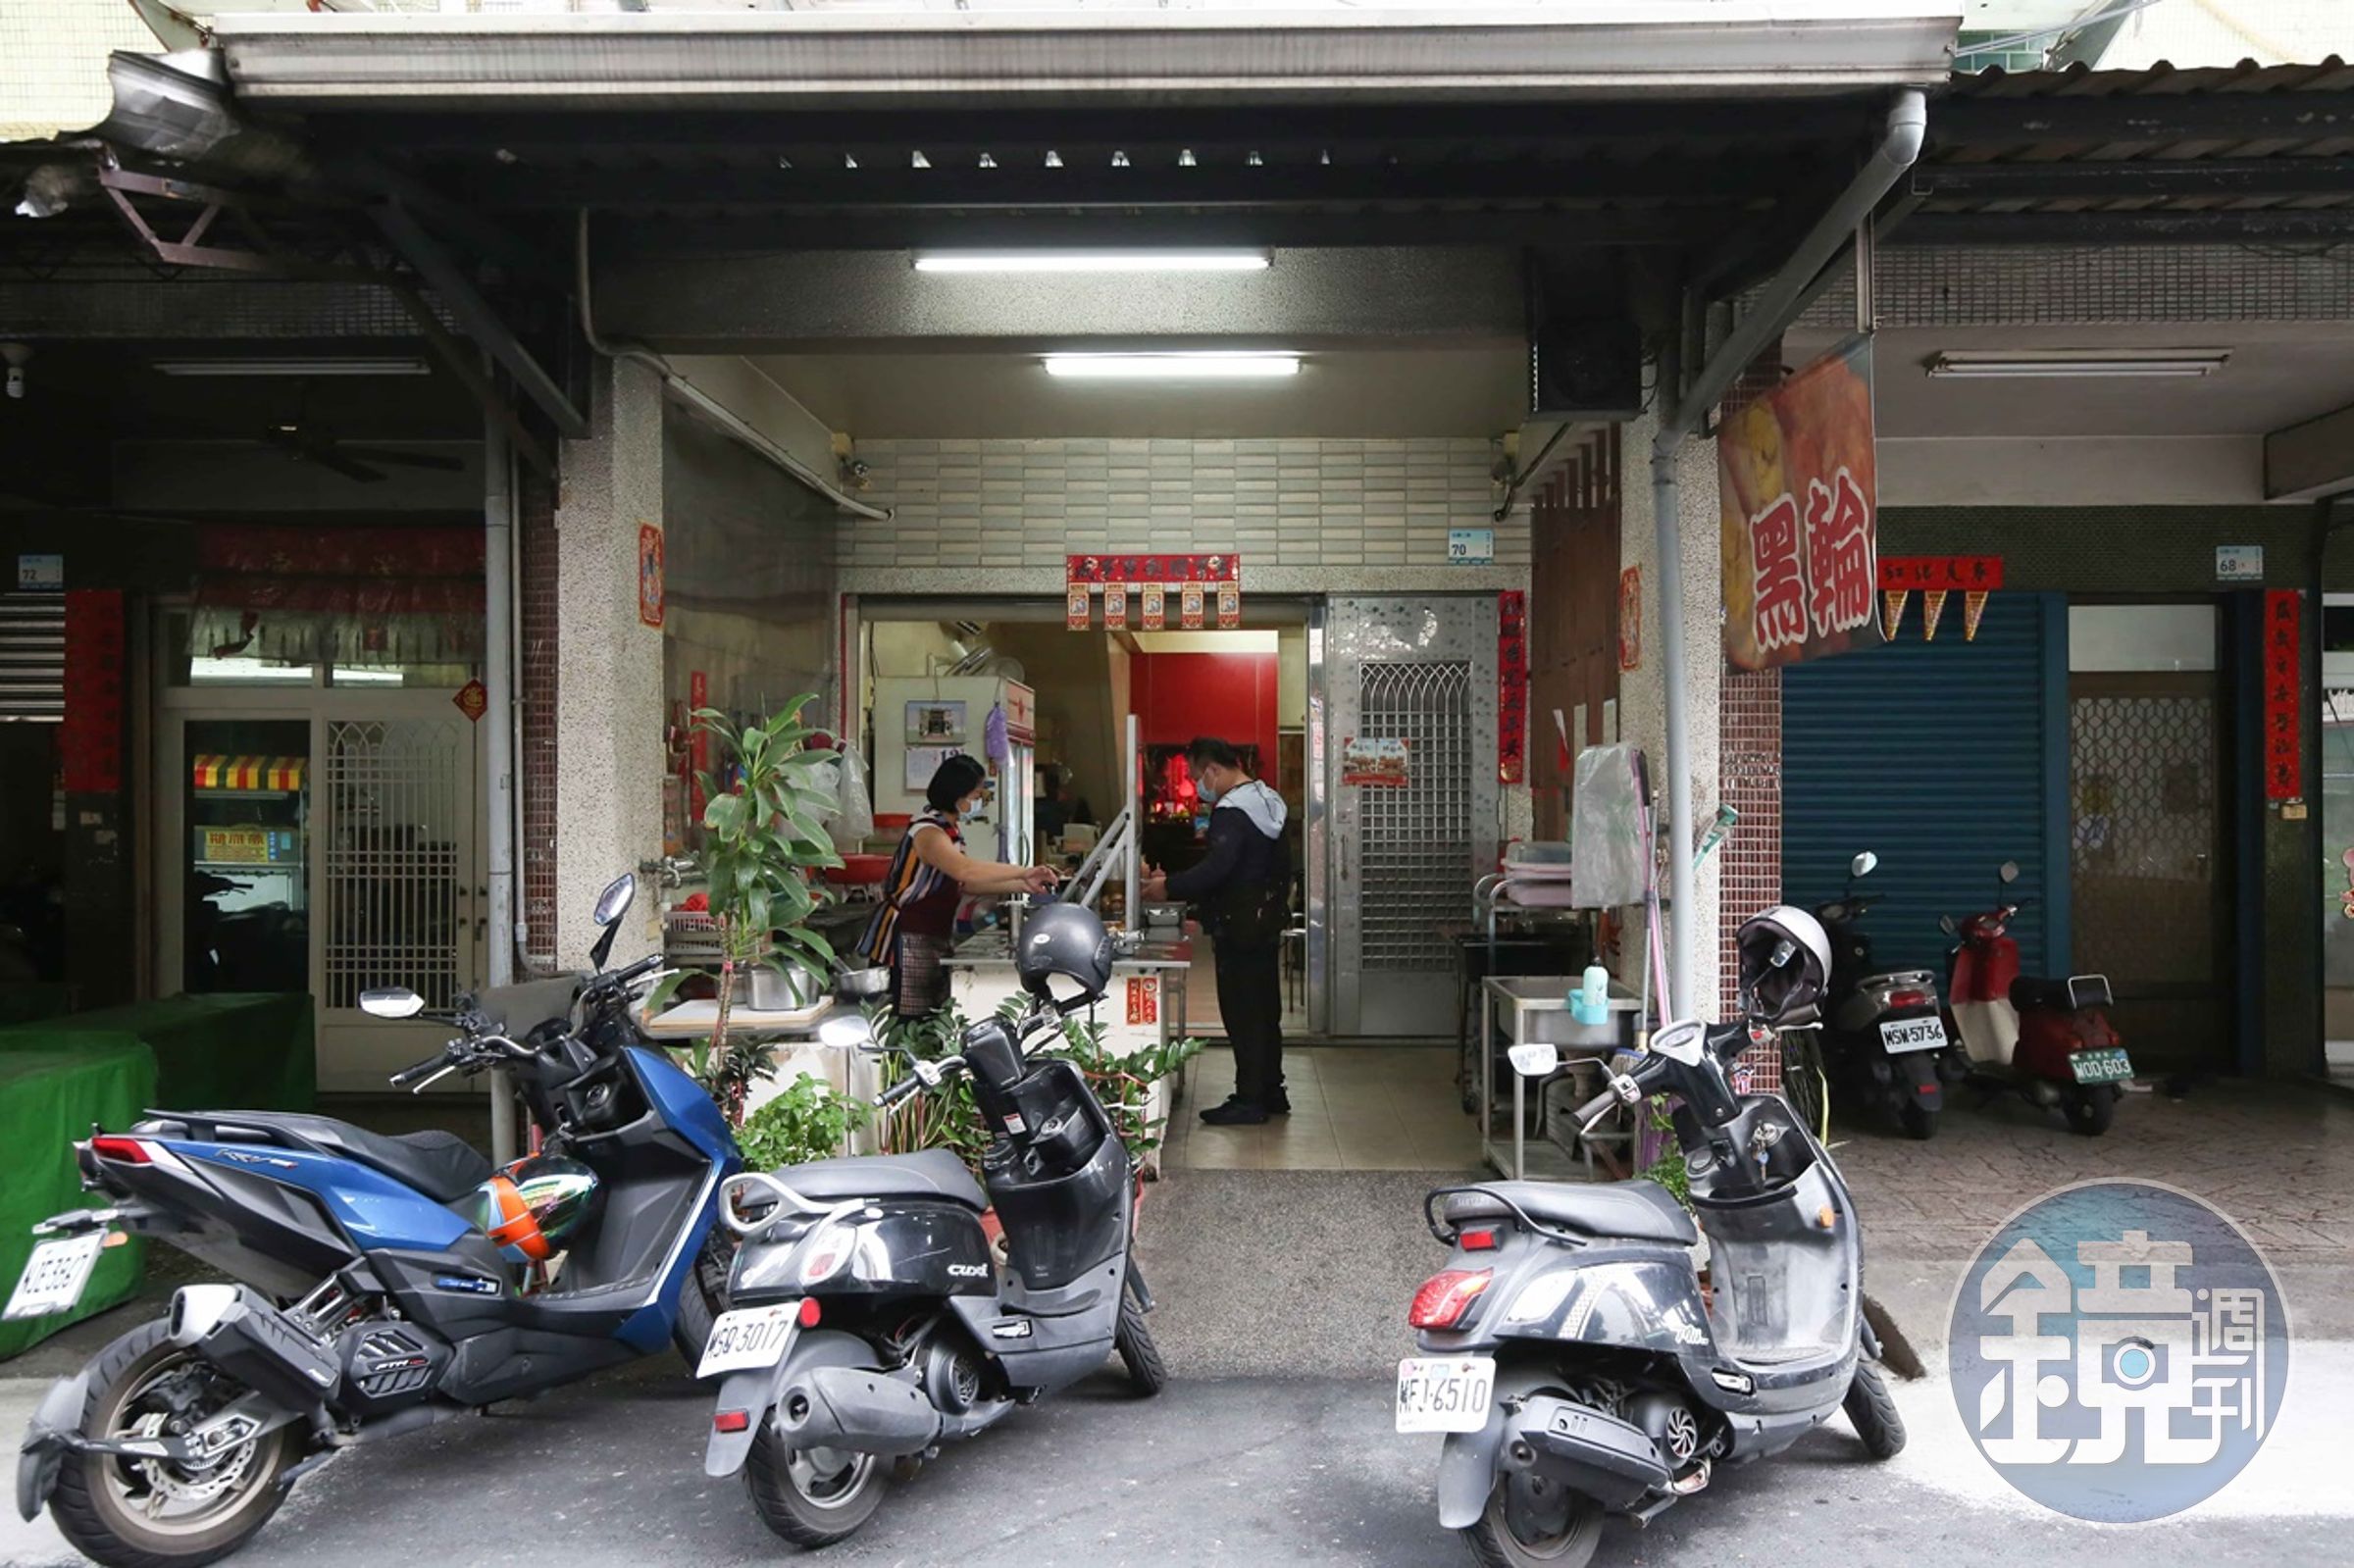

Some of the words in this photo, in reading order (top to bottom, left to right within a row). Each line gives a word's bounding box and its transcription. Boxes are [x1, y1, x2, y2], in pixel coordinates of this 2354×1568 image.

[1452, 543, 1466, 556] 70
[1750, 466, 1873, 654] 黑輪
[2220, 559, 2236, 573] 68
[22, 569, 37, 581] 72
[1883, 1024, 1943, 1046] MSW-5736
[1399, 1378, 1488, 1414] MFJ-6510
